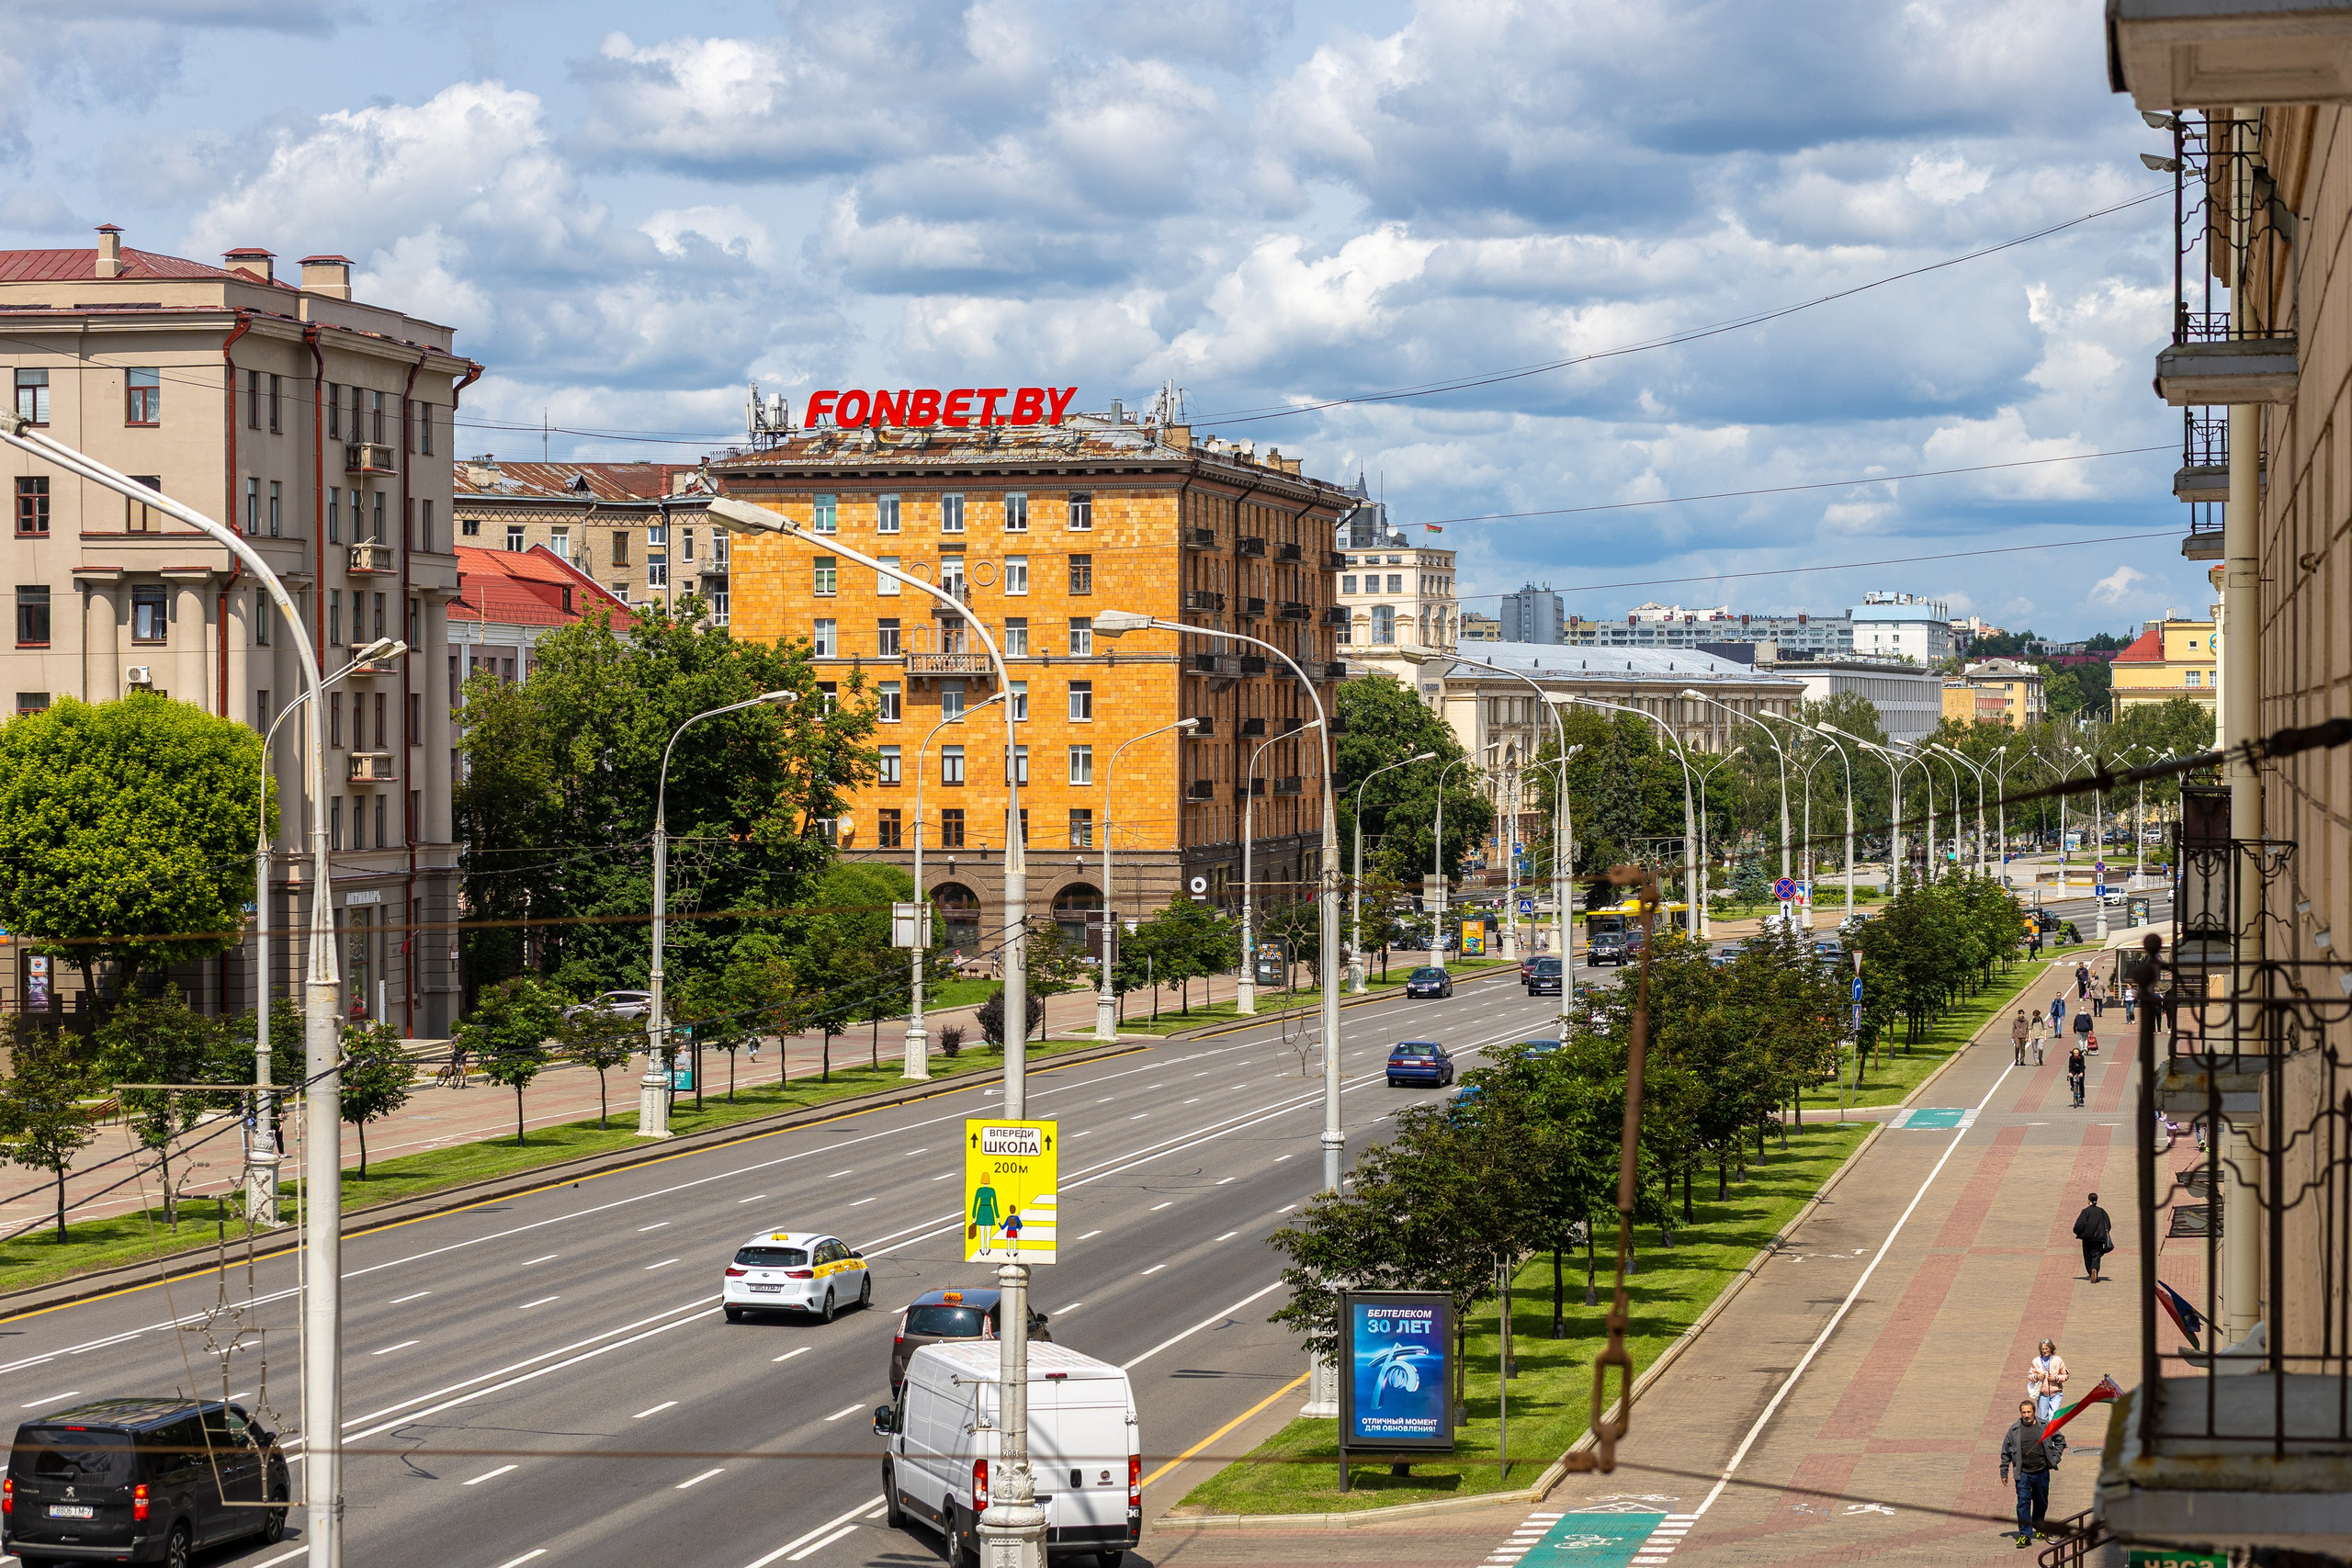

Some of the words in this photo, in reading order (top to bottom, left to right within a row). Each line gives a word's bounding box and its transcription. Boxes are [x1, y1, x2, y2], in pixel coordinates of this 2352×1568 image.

[804, 387, 1078, 428] FONBET.BY
[989, 1129, 1035, 1139] ВПЕРЕДИ
[984, 1141, 1038, 1154] ШКОЛА
[1367, 1309, 1432, 1318] БЕЛТЕЛЕКОМ
[1367, 1319, 1390, 1333] 30
[1396, 1319, 1432, 1334] ЛЕТ
[1003, 1450, 1017, 1458] 208
[56, 1506, 73, 1515] 8806
